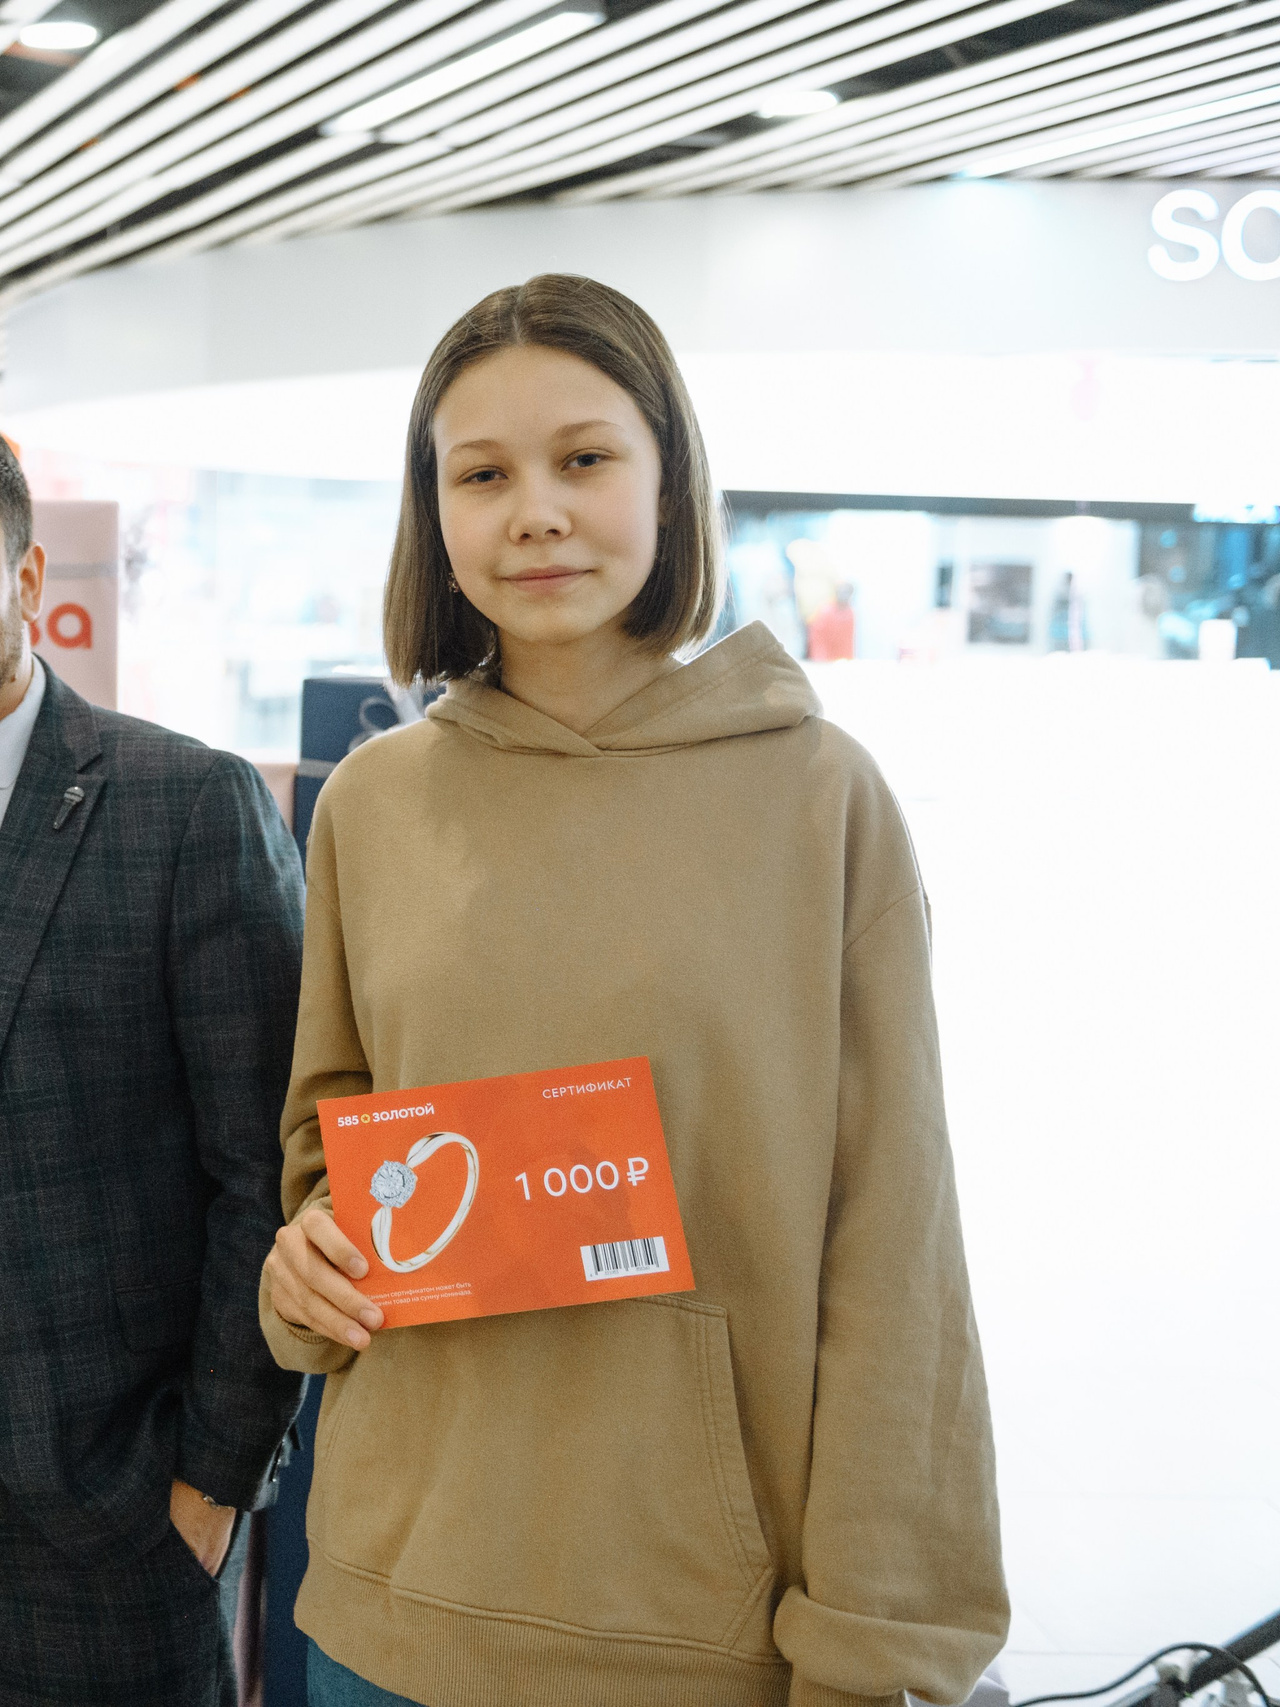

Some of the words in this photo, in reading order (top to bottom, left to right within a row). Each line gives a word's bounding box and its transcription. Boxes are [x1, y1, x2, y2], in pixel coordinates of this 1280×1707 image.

[542, 1077, 632, 1100] СЕРТИФИКАТ
[337, 1114, 360, 1127] 585
[372, 1102, 435, 1123] ЗОЛОТОЙ
